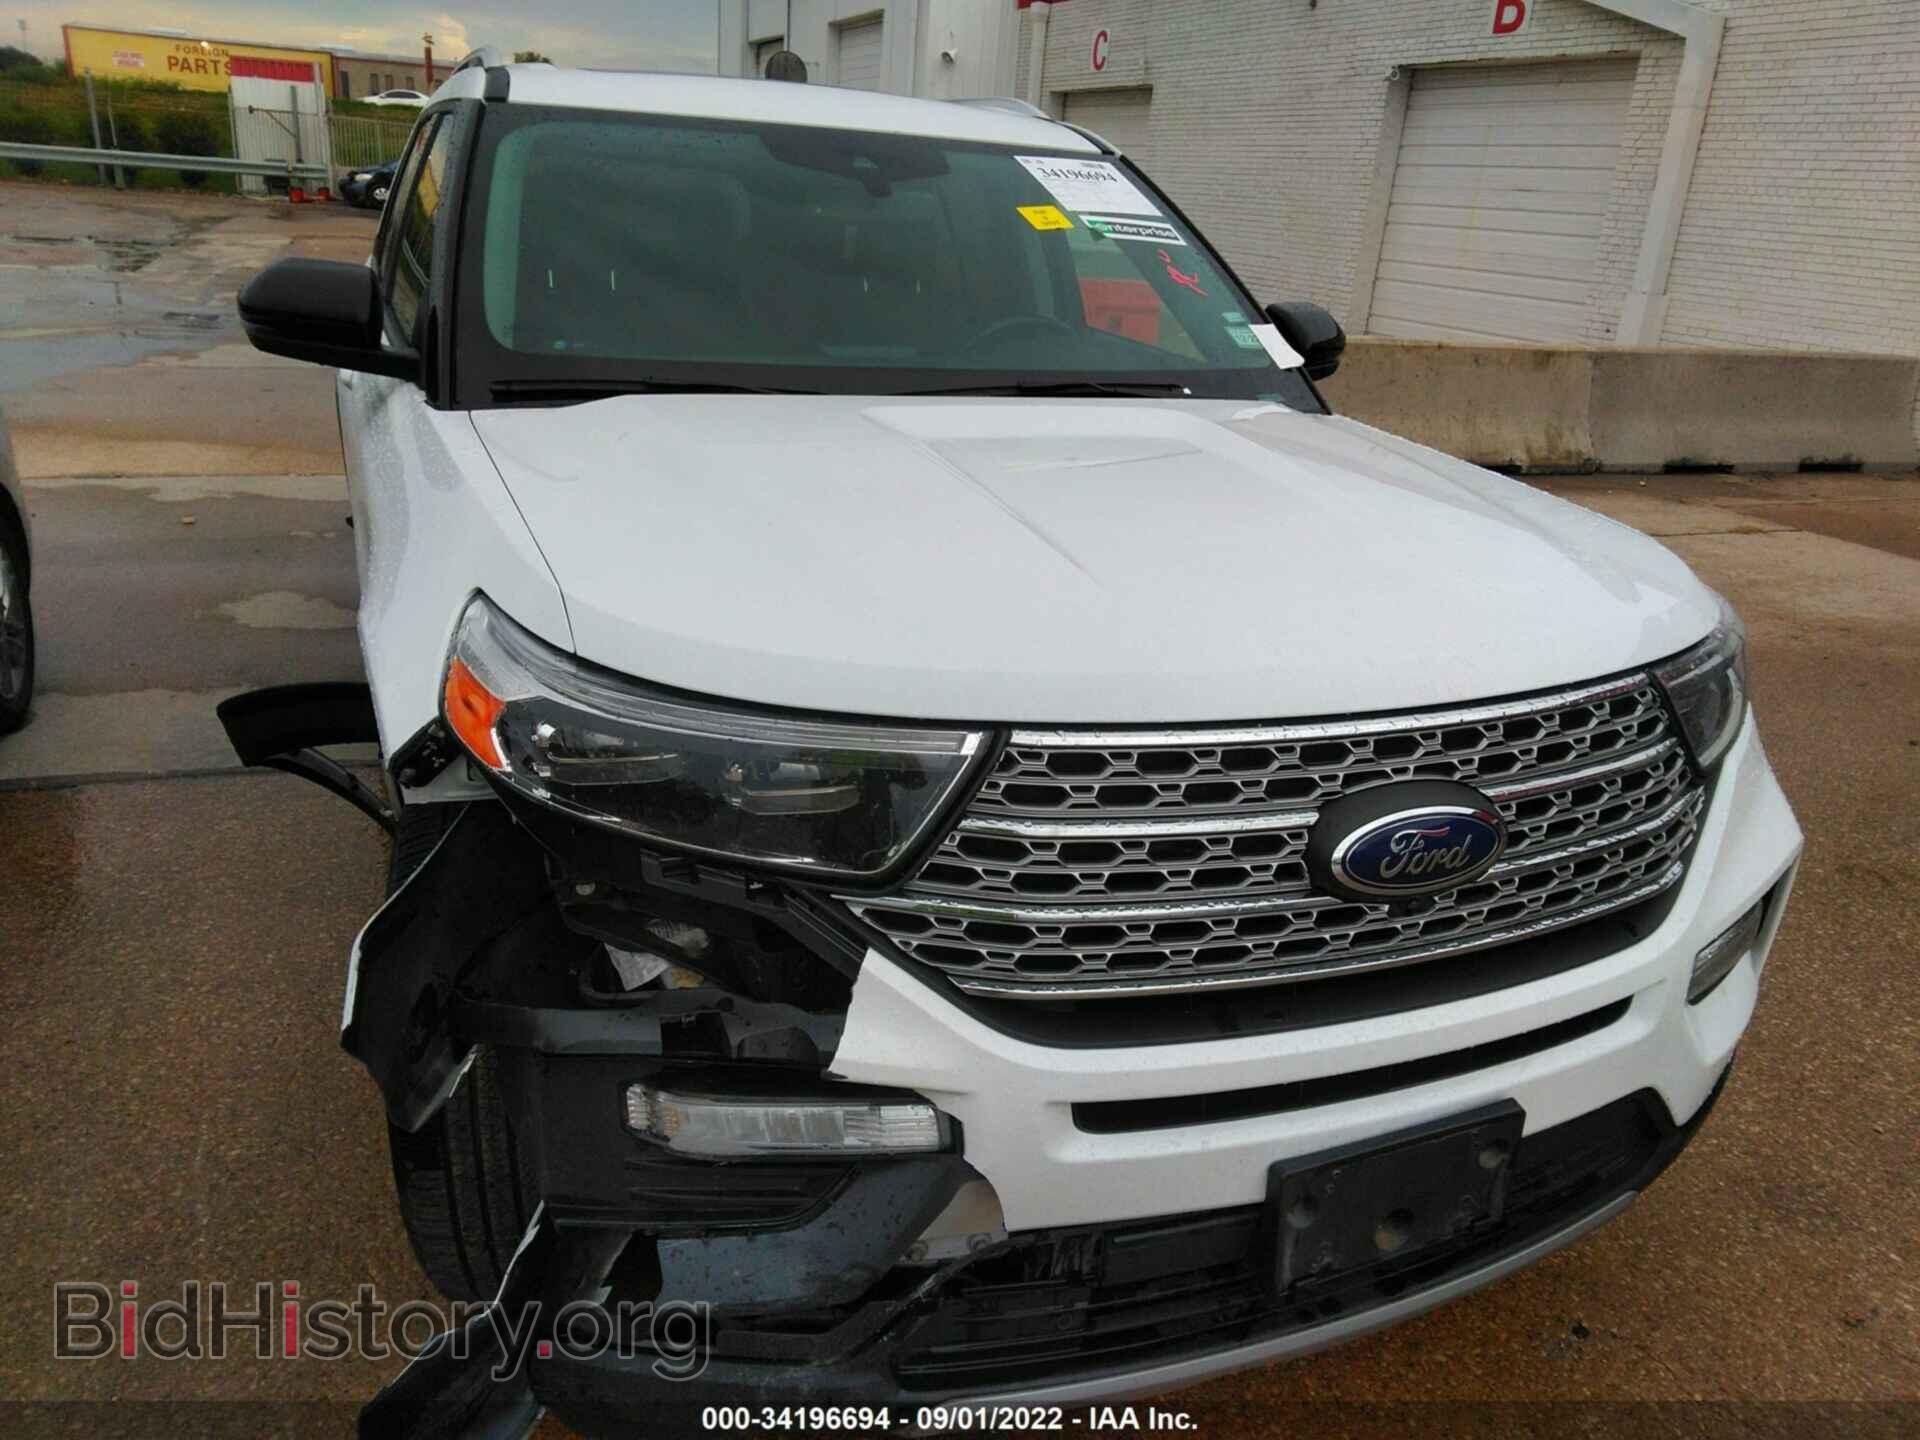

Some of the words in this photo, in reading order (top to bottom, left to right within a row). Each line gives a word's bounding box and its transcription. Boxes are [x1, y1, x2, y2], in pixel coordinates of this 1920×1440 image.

[1493, 0, 1526, 34] D
[175, 44, 230, 57] FOREIGN
[1093, 30, 1108, 71] C
[1037, 167, 1118, 182] 34196694
[1379, 826, 1473, 880] Ford
